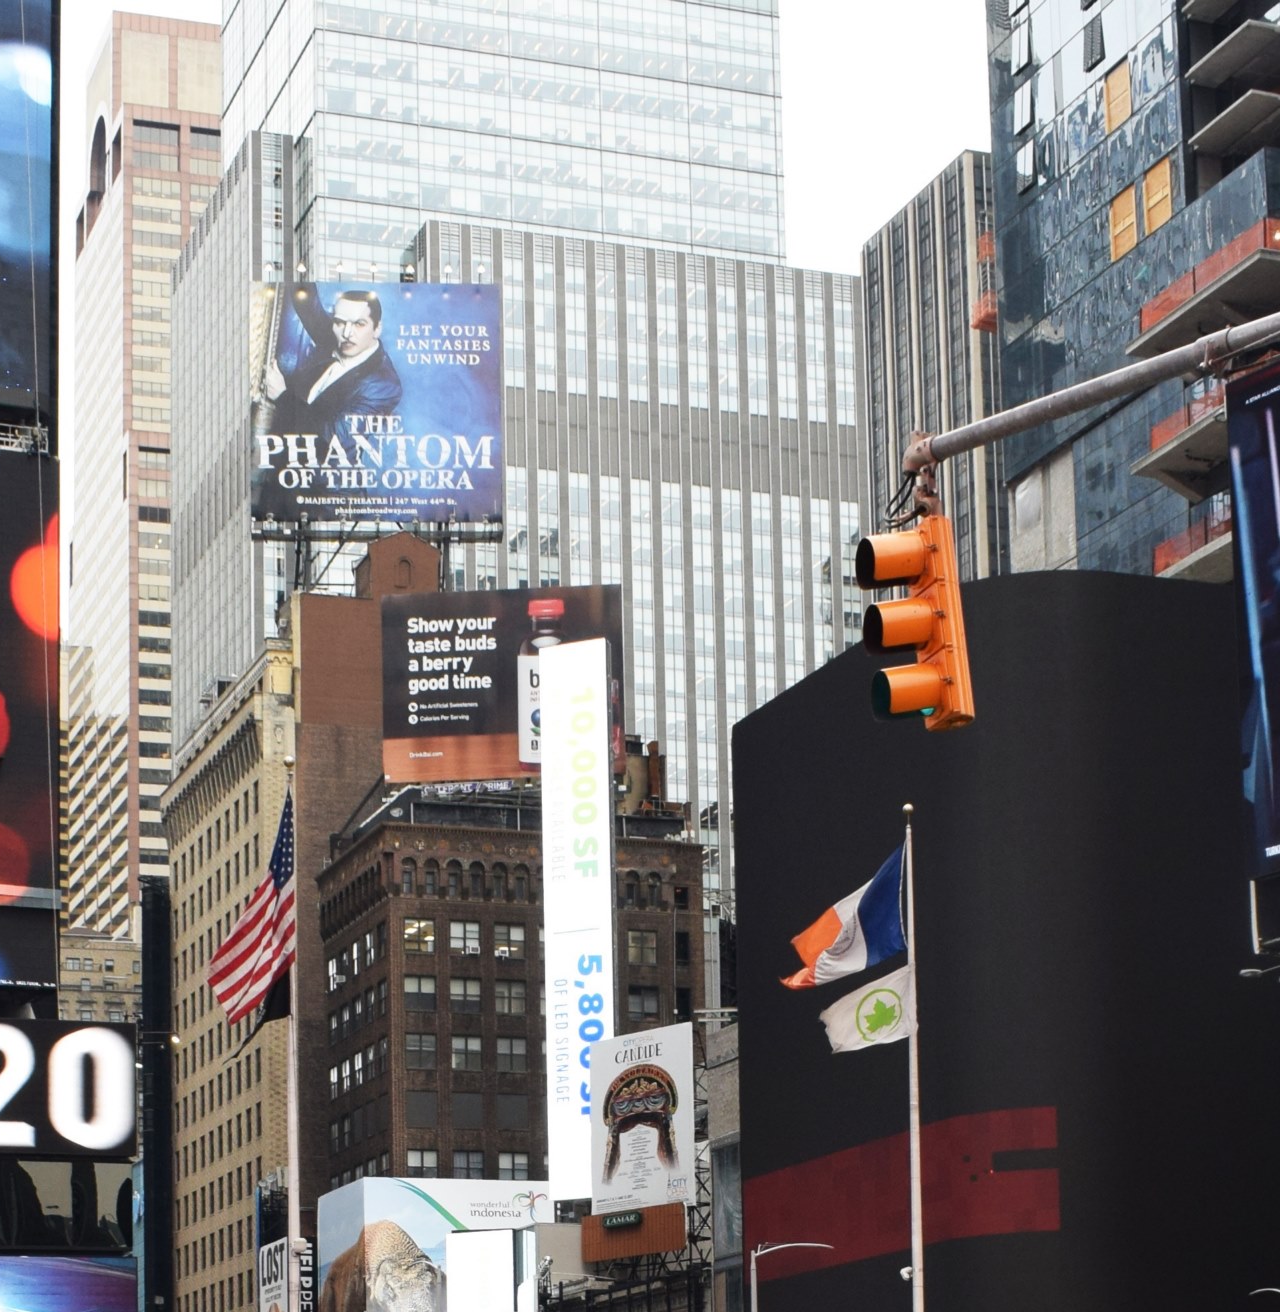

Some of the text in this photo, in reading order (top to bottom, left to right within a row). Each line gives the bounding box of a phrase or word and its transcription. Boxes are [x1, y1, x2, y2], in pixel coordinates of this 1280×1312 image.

[400, 325, 489, 337] LET YOUR
[397, 339, 491, 351] FANTASIES
[407, 354, 480, 365] UNWIND
[345, 415, 404, 436] THE
[257, 433, 494, 470] PHANTOM
[278, 468, 474, 490] OF THE OPERA
[335, 507, 417, 516] phantombroadway.com
[407, 616, 497, 635] Show your
[408, 635, 497, 654] taste buds
[408, 656, 473, 674] a berry
[408, 673, 492, 695] good time
[573, 836, 599, 878] SF
[554, 978, 570, 1104] OF LED SIGNAGE
[615, 1042, 663, 1064] CANDIDE
[470, 1201, 510, 1210] wonderful
[470, 1209, 522, 1218] indonesia
[261, 1243, 285, 1287] LOST
